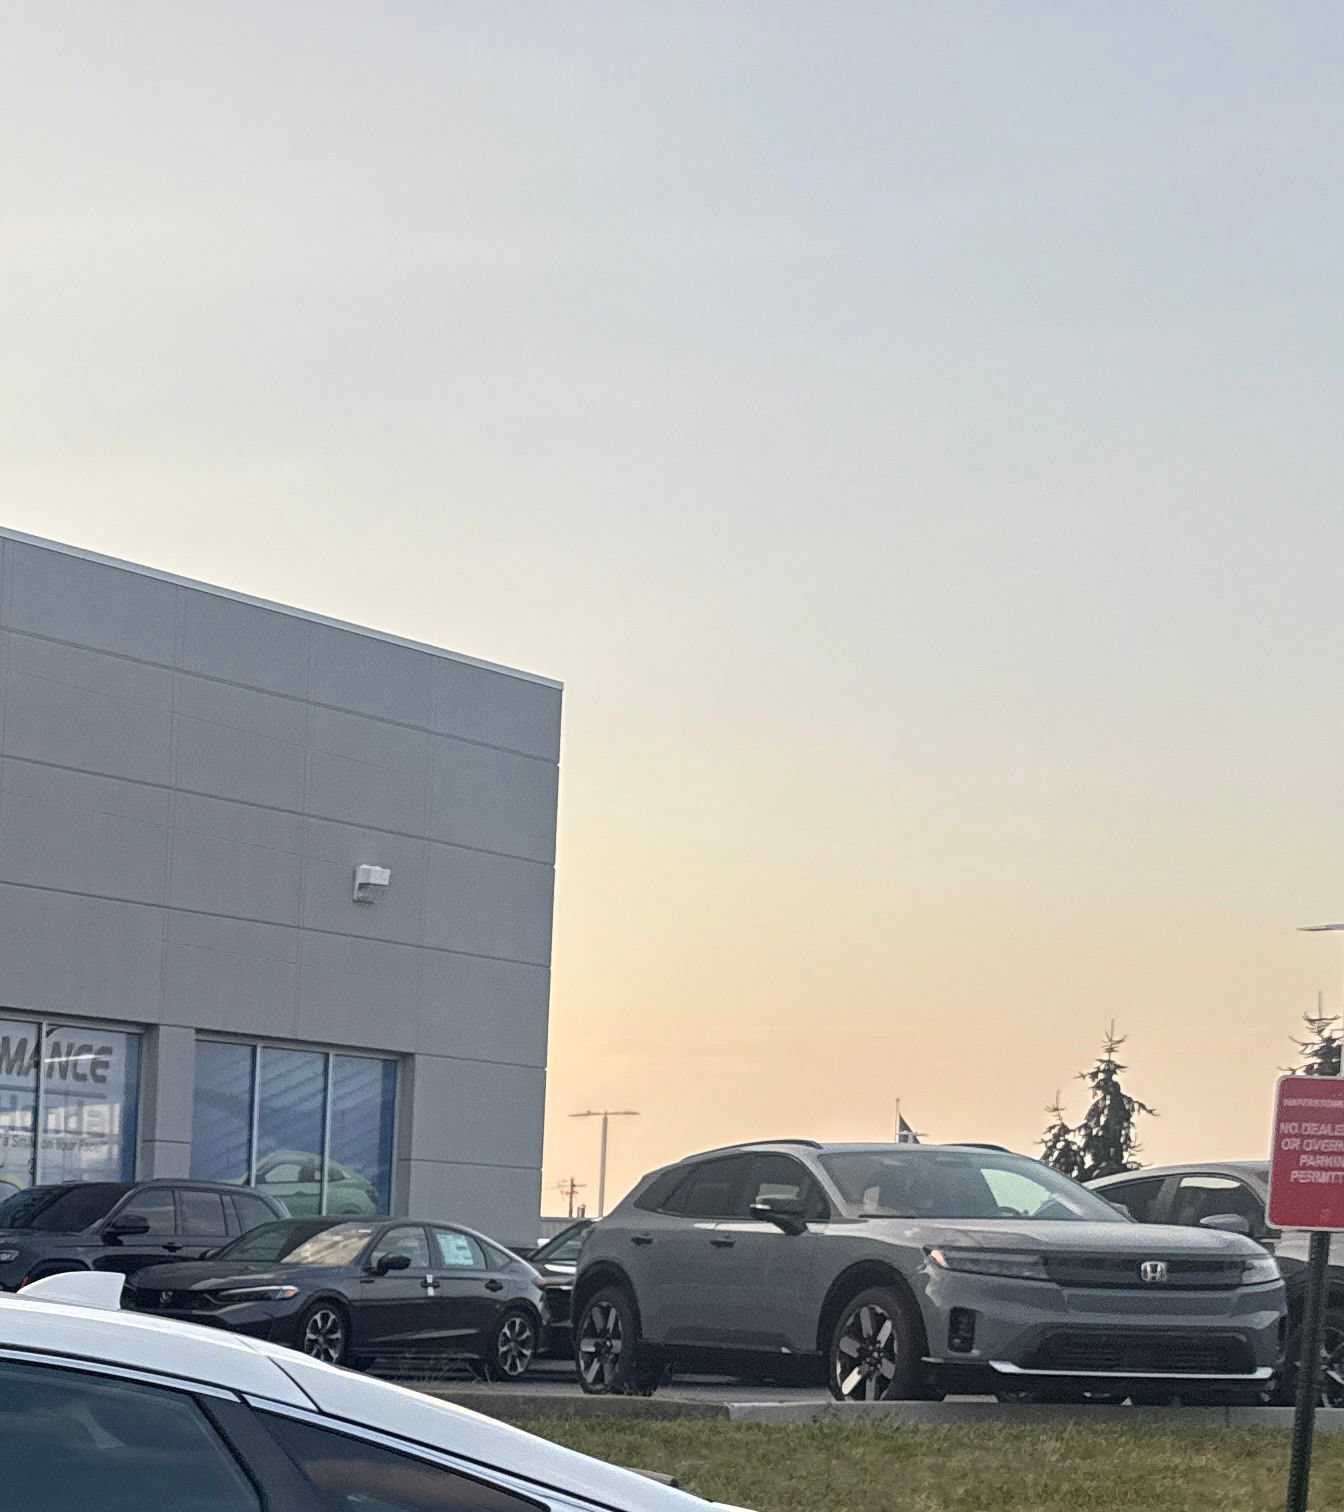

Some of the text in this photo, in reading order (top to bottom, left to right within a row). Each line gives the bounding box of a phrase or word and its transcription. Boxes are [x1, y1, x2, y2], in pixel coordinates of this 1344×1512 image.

[1279, 1122, 1298, 1135] NO
[1281, 1138, 1344, 1153] OR OVER
[1299, 1154, 1344, 1168] PARKIN
